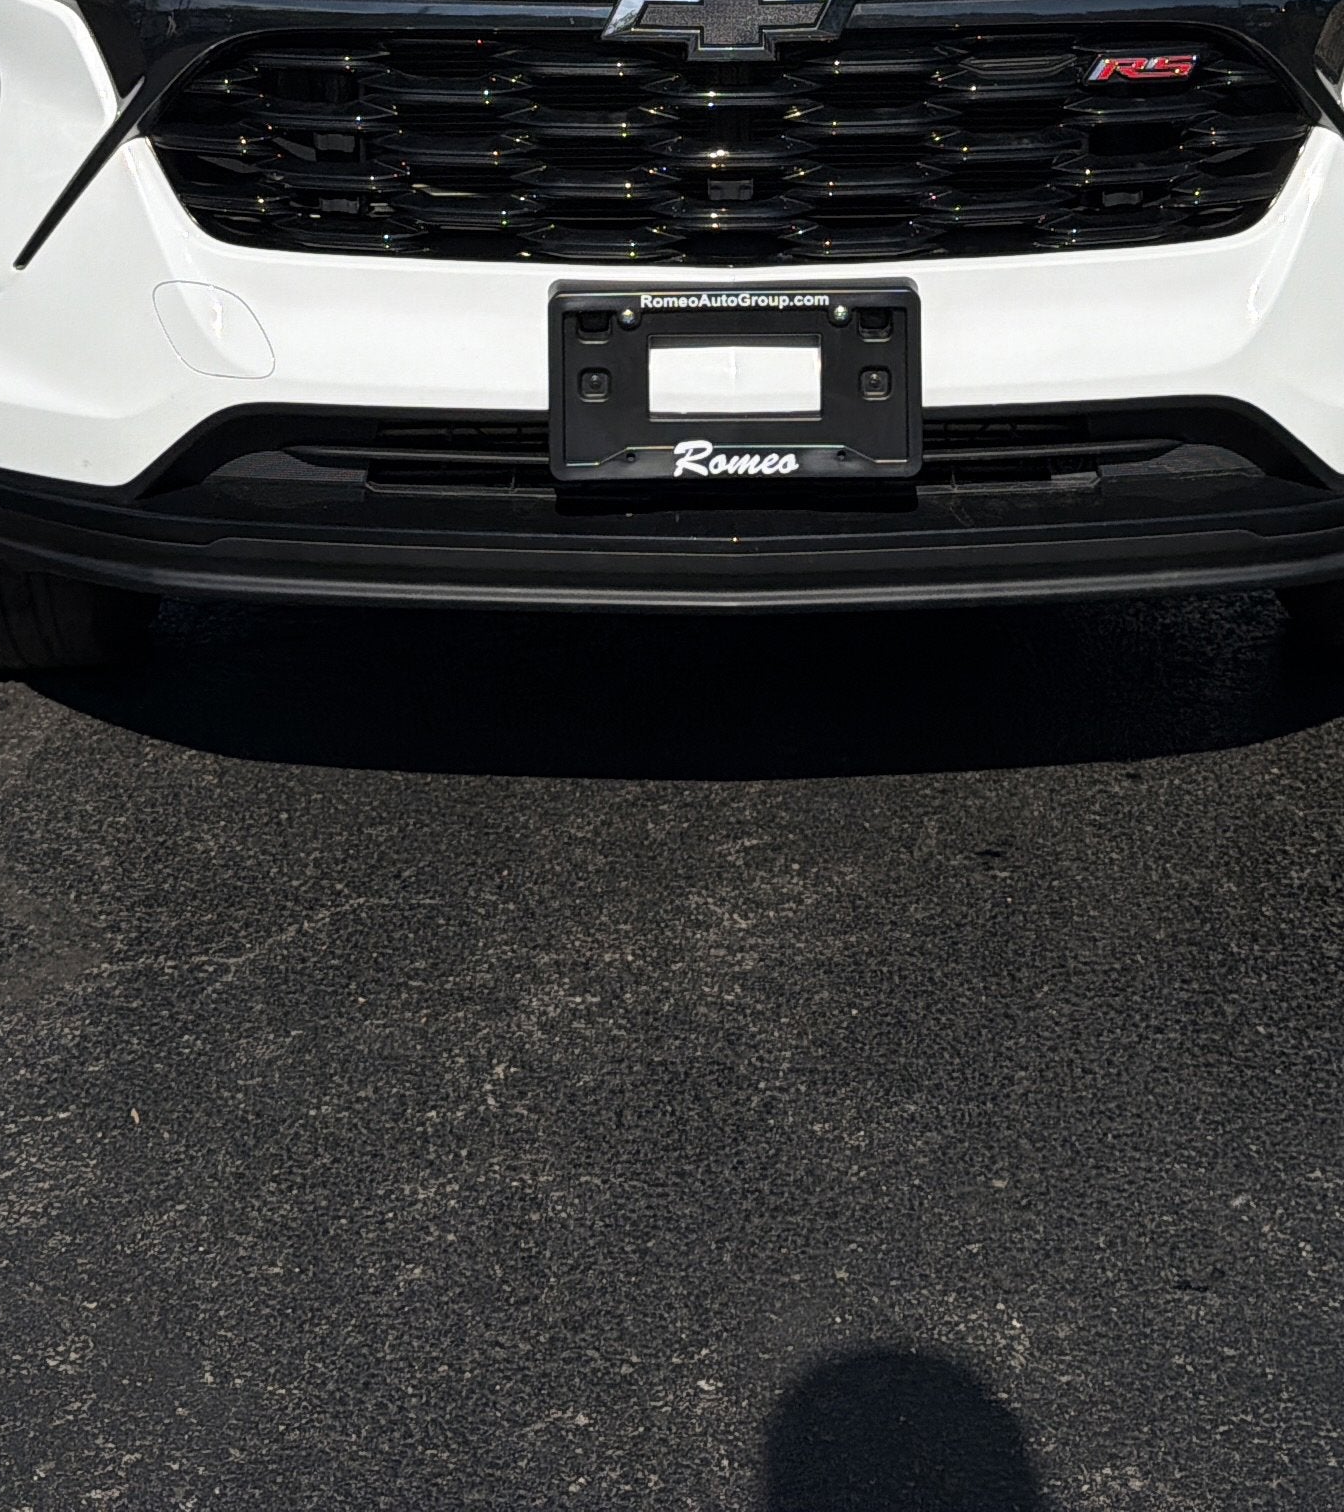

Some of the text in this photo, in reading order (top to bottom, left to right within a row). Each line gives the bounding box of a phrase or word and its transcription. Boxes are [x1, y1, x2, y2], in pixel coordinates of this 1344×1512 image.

[1088, 54, 1199, 82] RS
[640, 293, 830, 309] RomeoAutoGroup.com
[673, 440, 800, 477] Romeo
